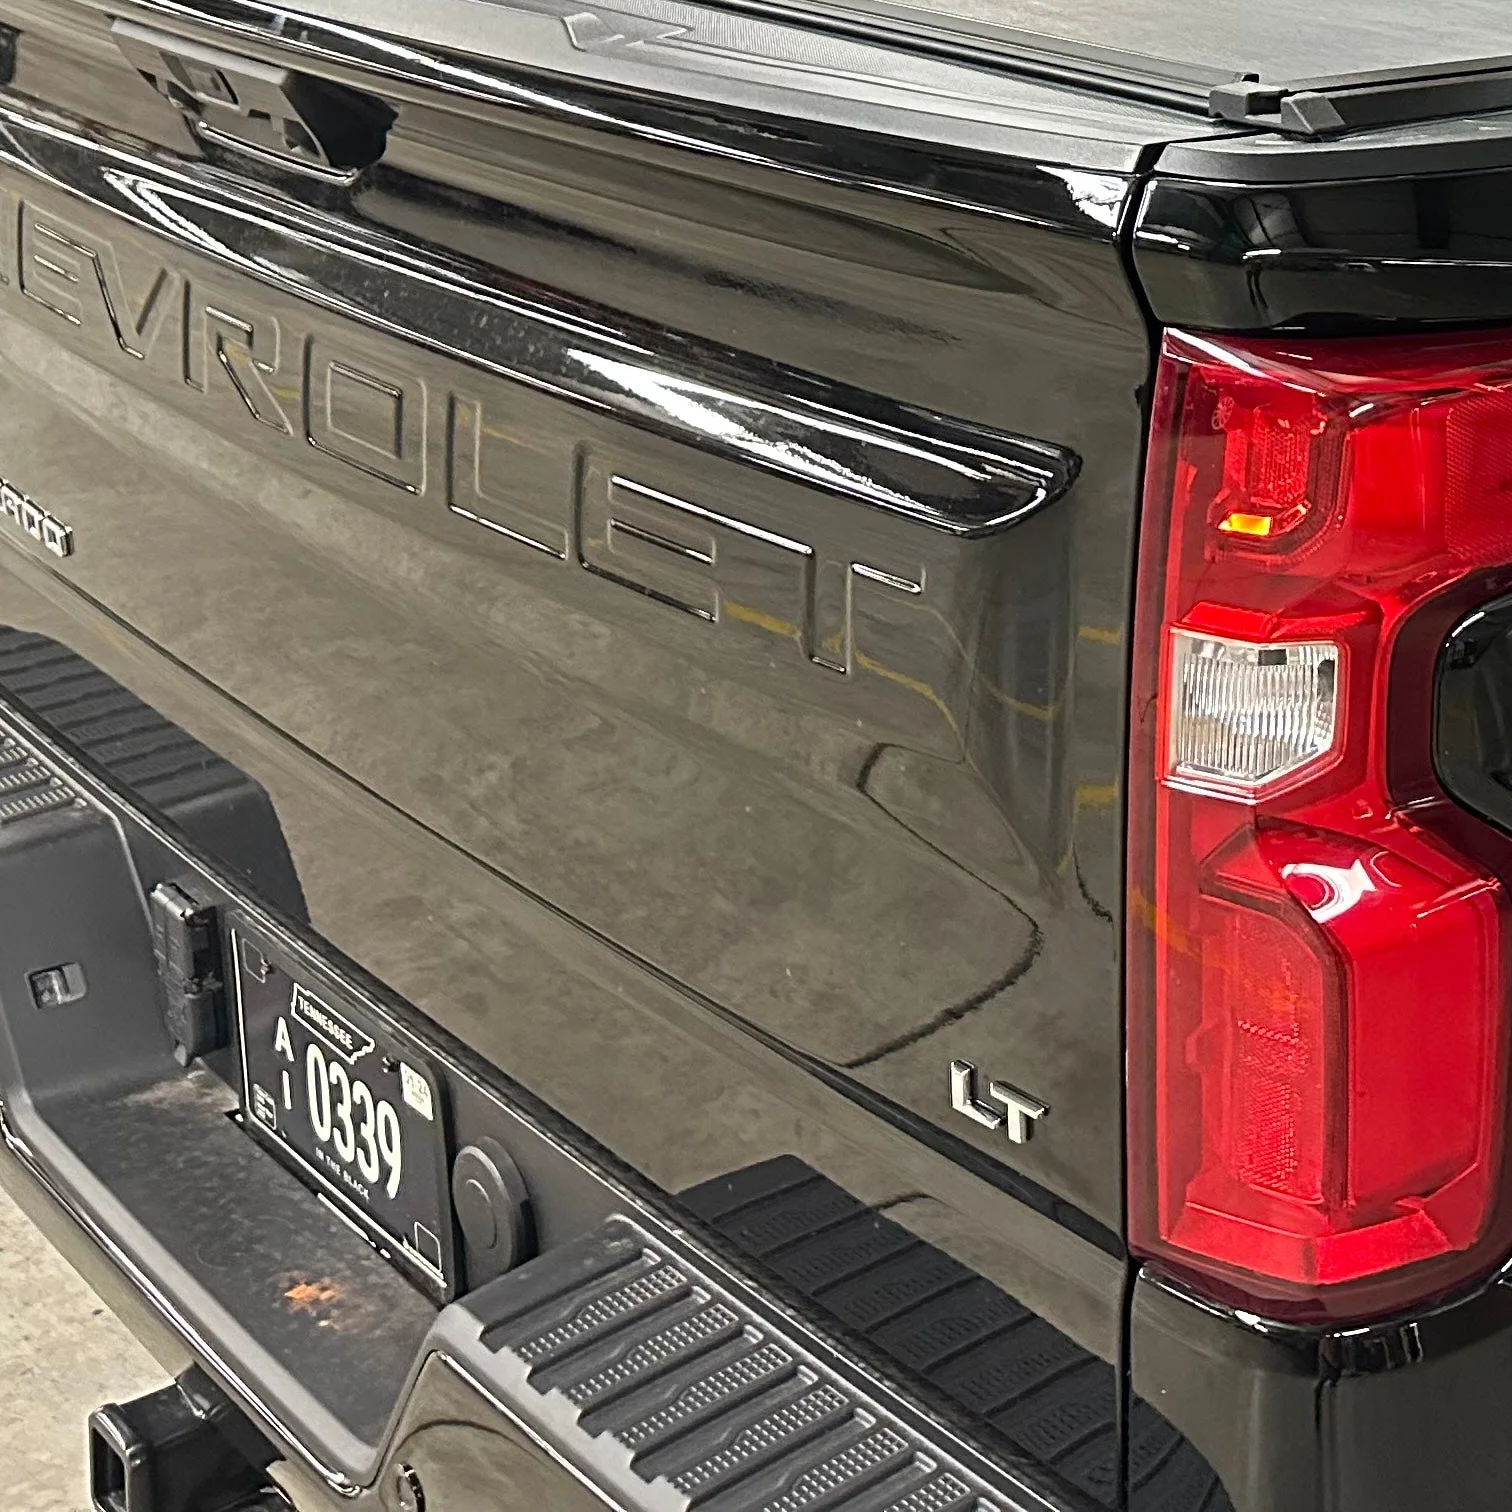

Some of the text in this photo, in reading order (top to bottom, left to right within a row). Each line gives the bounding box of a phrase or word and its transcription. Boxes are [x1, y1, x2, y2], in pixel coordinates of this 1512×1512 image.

[0, 198, 926, 676] EVROLET
[298, 995, 354, 1050] TENNESSEE
[306, 1043, 402, 1200] 0339
[949, 1059, 1050, 1144] LT
[326, 1155, 341, 1176] THE
[343, 1170, 369, 1204] BLACK
